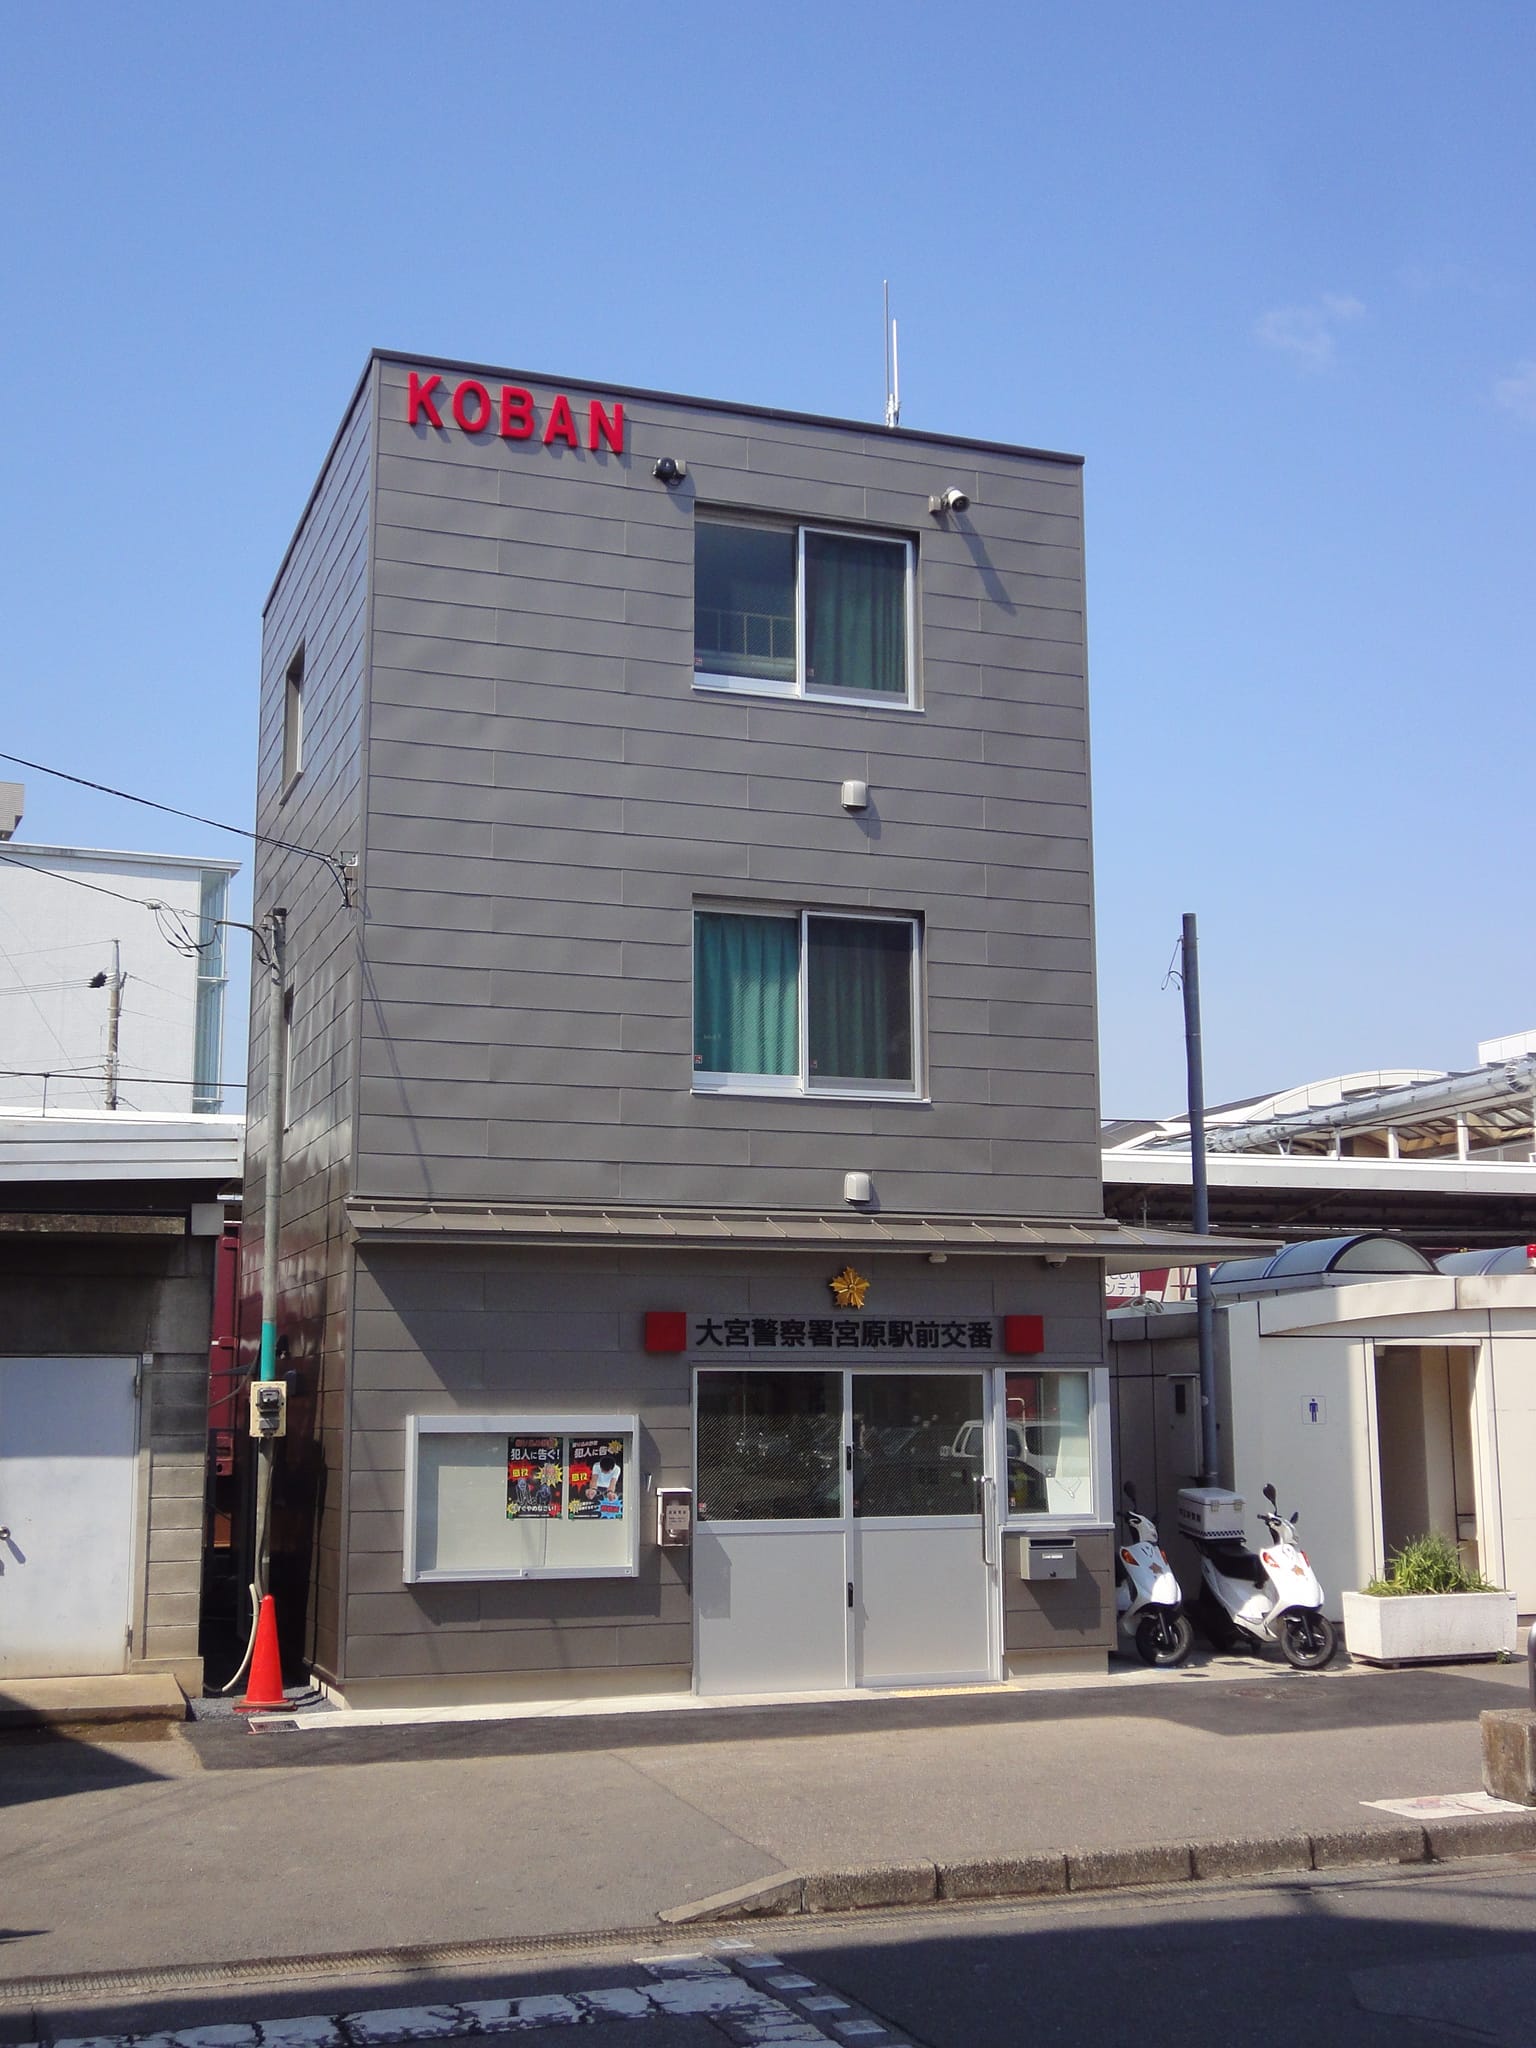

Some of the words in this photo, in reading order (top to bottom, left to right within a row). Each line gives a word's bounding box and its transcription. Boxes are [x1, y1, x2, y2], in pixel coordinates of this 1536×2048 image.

[408, 371, 623, 453] KOBAN
[695, 1317, 993, 1349] 大宮警察署宮原駅前交番
